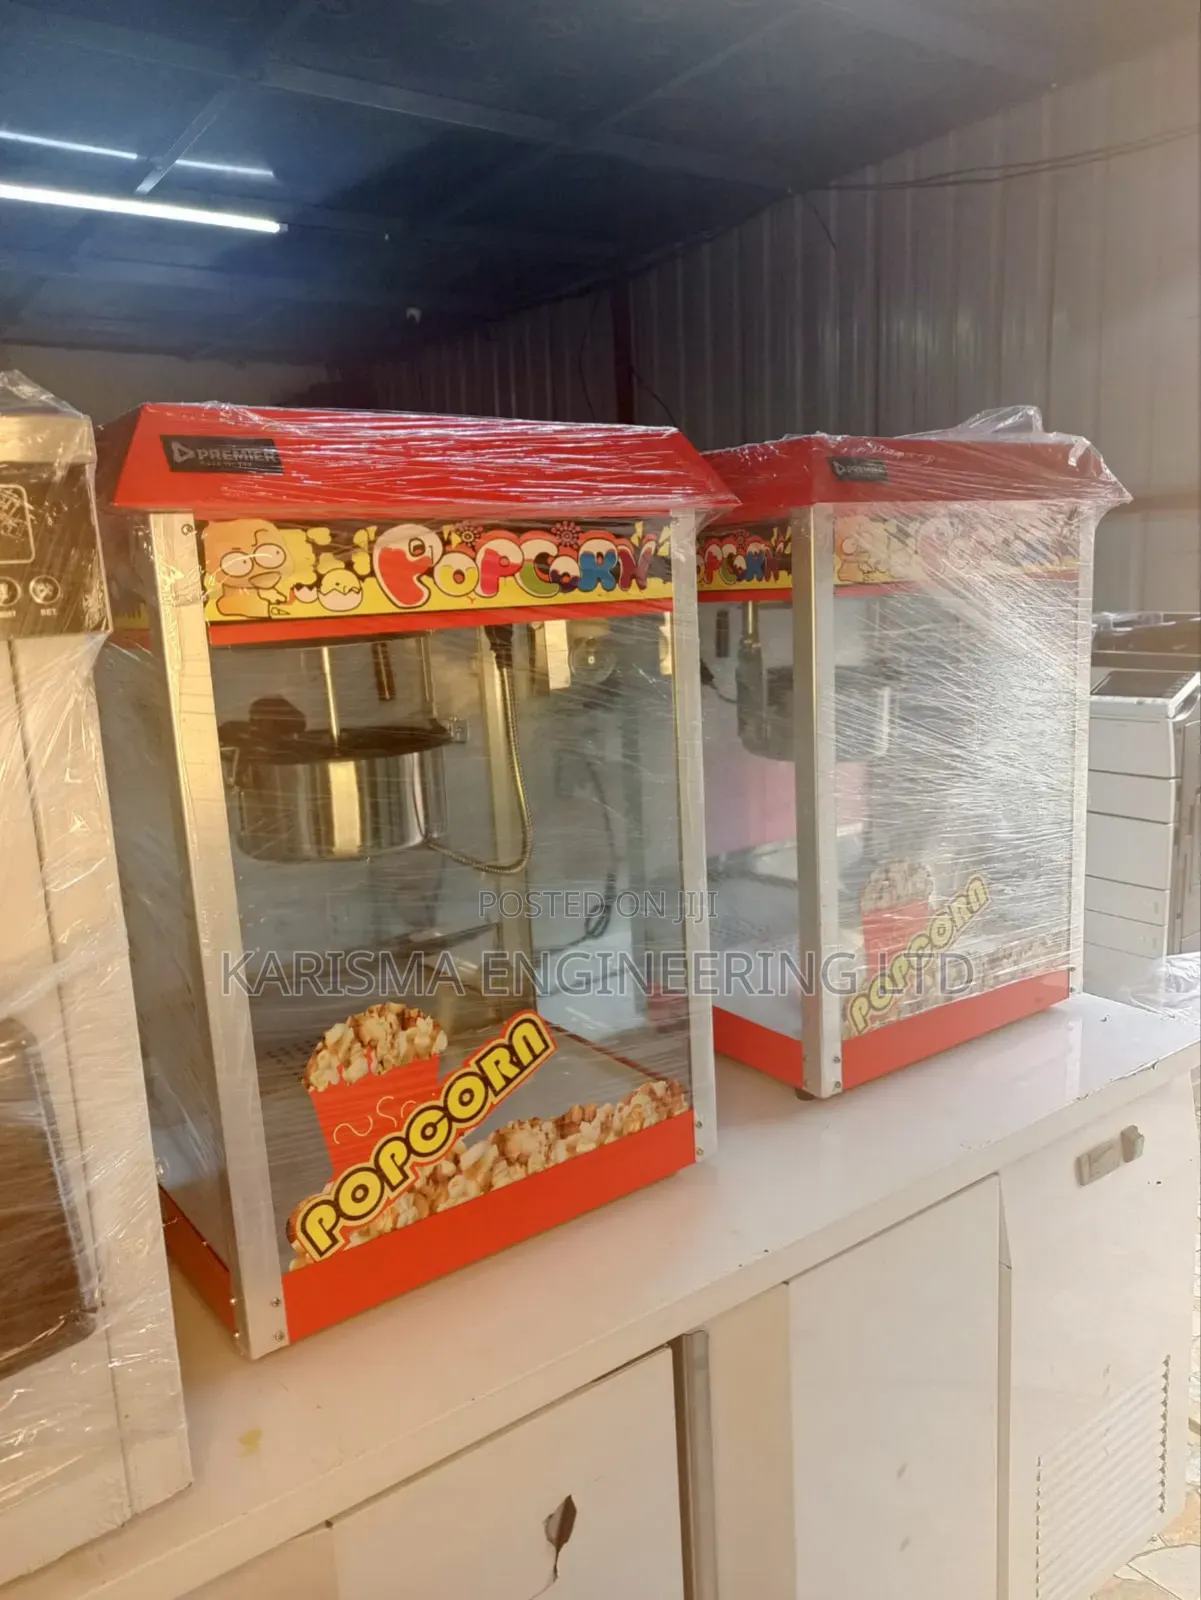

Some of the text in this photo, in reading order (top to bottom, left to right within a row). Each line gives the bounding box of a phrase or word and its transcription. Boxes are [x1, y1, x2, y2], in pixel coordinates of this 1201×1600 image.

[373, 523, 655, 609] POPCORN
[847, 873, 990, 1034] POPCORN
[298, 1014, 555, 1260] POPCORN
